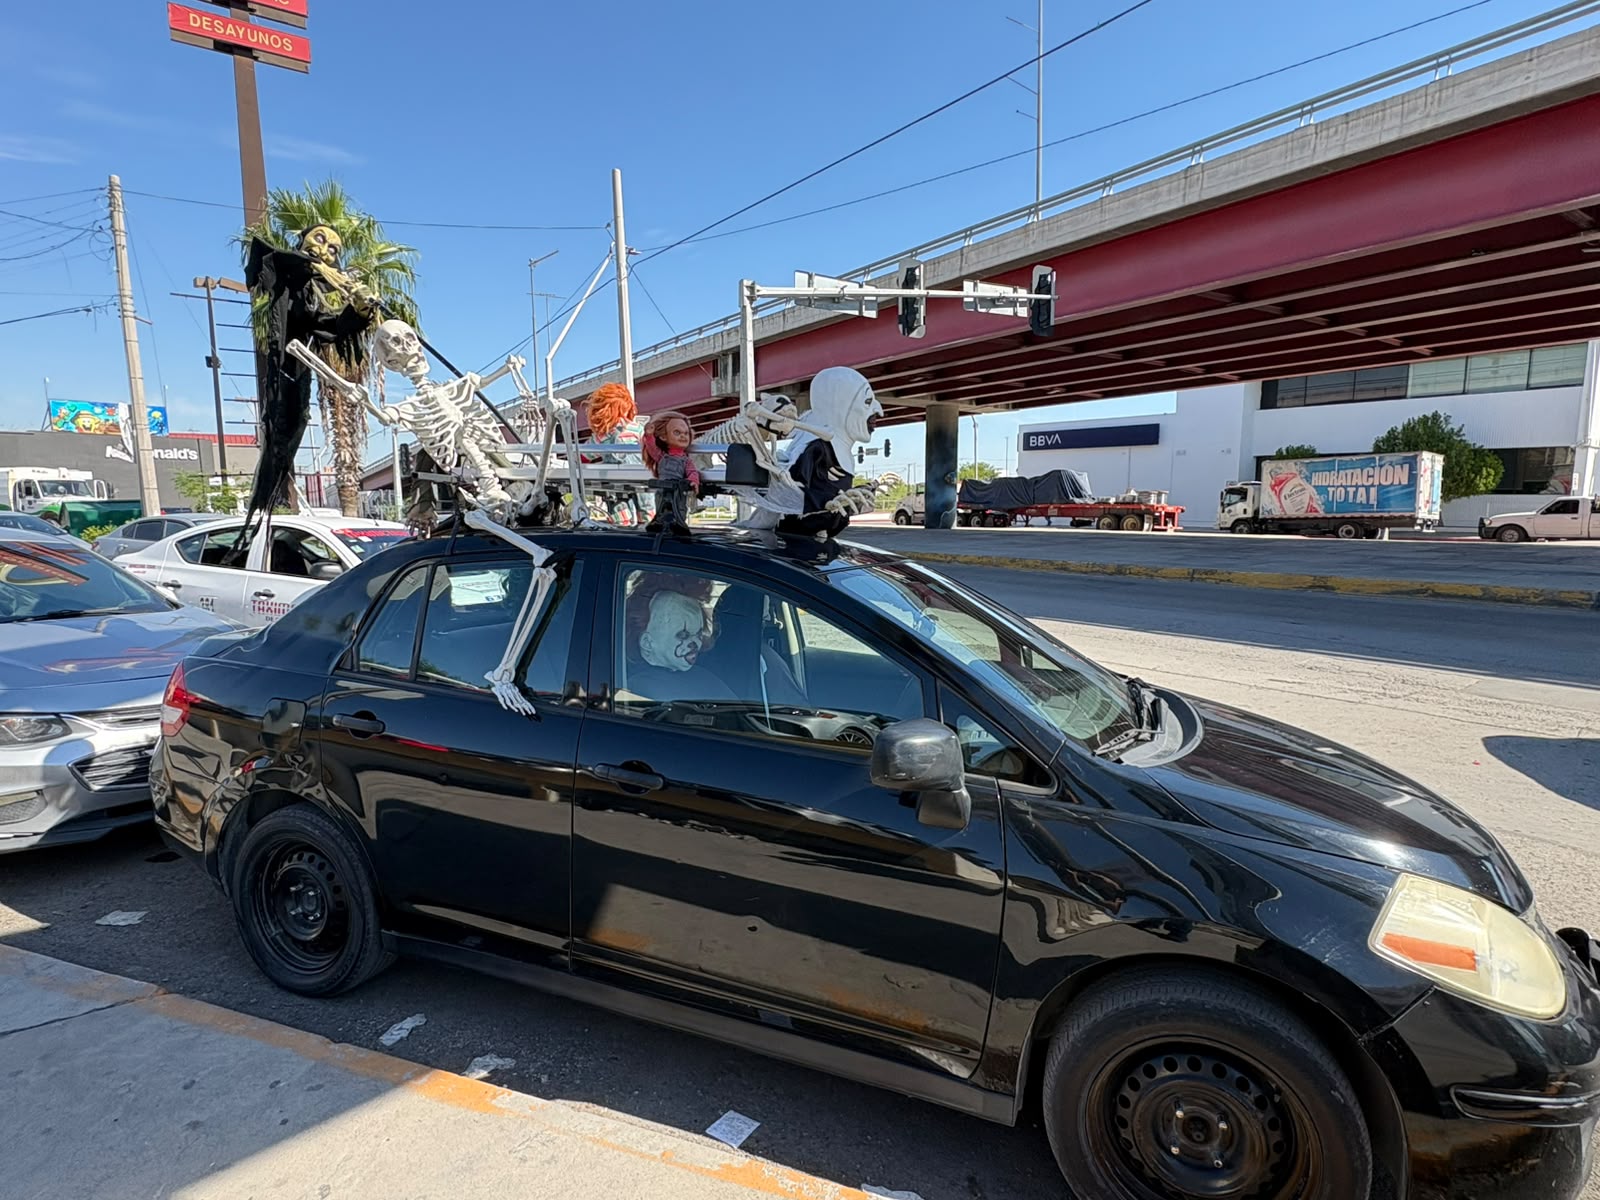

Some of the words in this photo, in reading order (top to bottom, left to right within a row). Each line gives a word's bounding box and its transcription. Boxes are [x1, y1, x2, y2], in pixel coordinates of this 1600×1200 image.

[188, 13, 293, 52] DESAYUNOS
[1029, 433, 1062, 447] BBVA
[1311, 463, 1410, 486] HIDRATACIÓN
